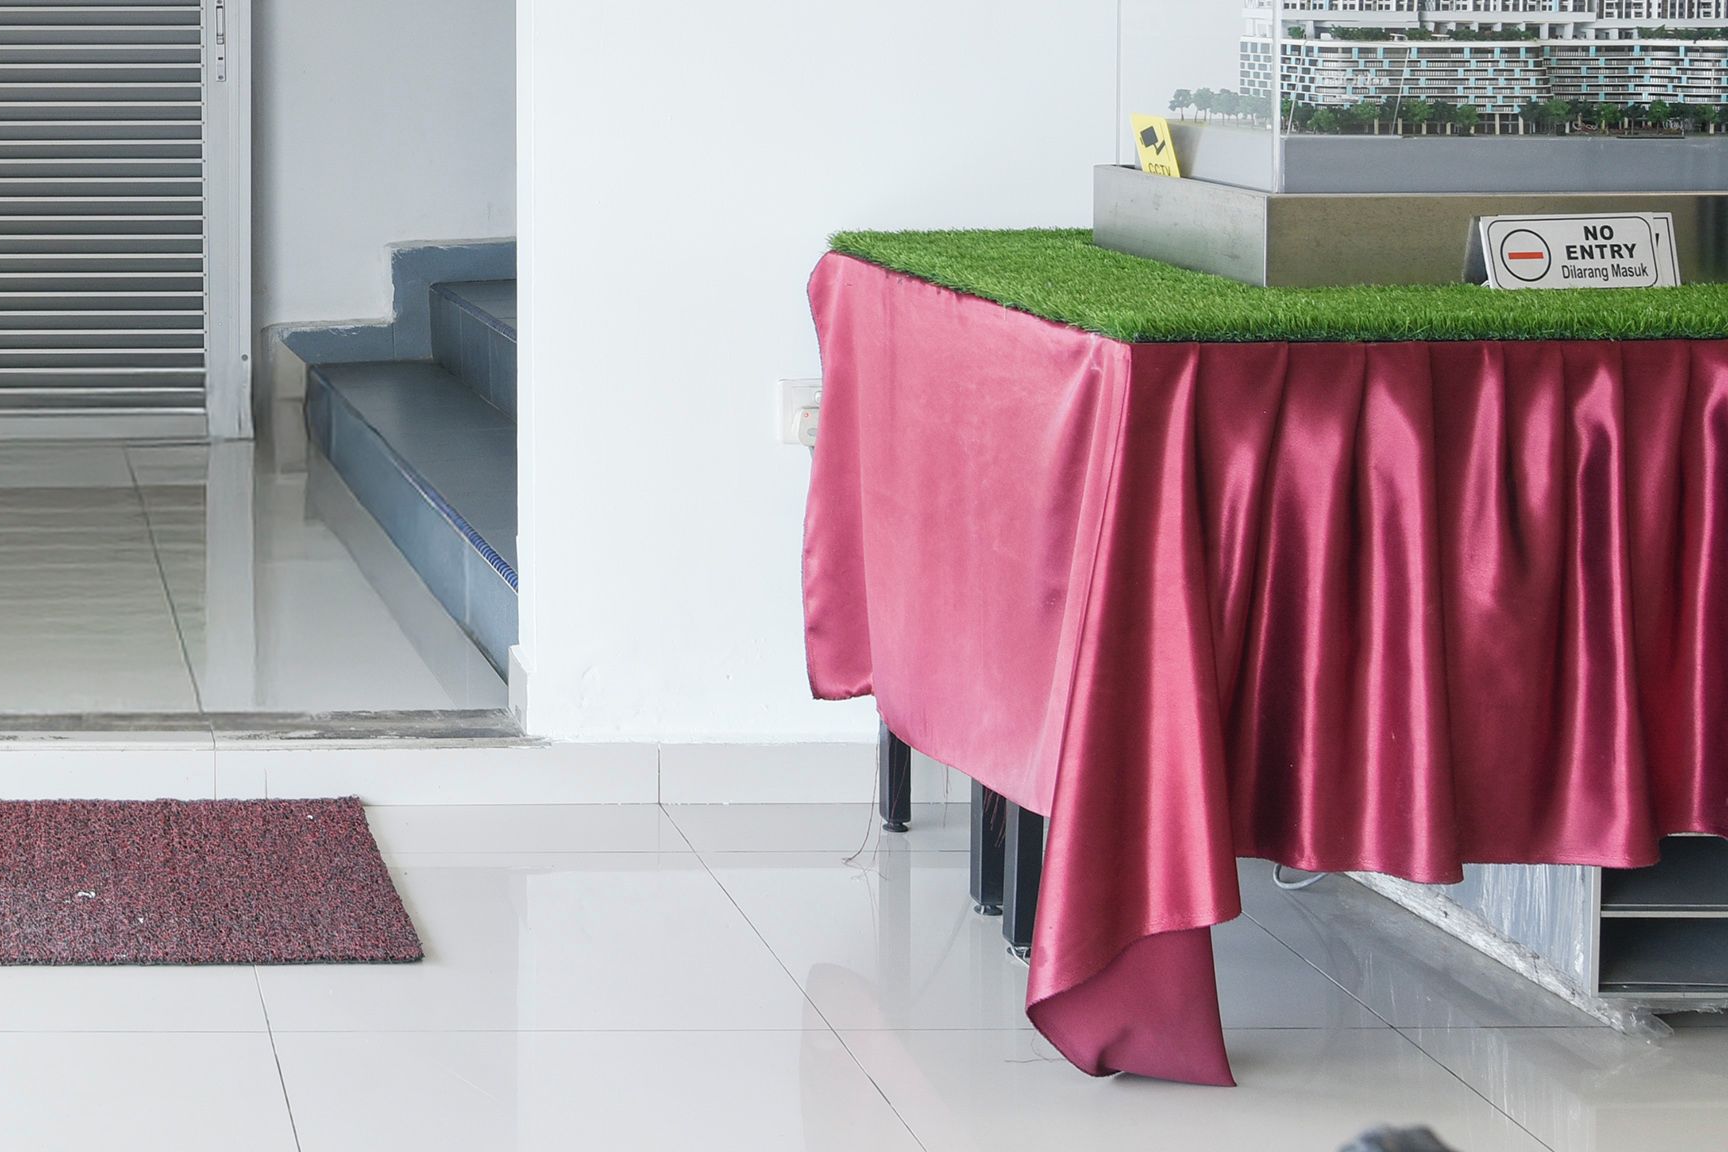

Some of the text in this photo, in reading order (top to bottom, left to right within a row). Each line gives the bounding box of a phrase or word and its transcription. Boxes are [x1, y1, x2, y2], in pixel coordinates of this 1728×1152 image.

[1148, 162, 1171, 176] CCTV
[1583, 225, 1614, 241] NO
[1565, 243, 1636, 260] ENTRY
[1561, 262, 1649, 282] Dilarang Masuk
